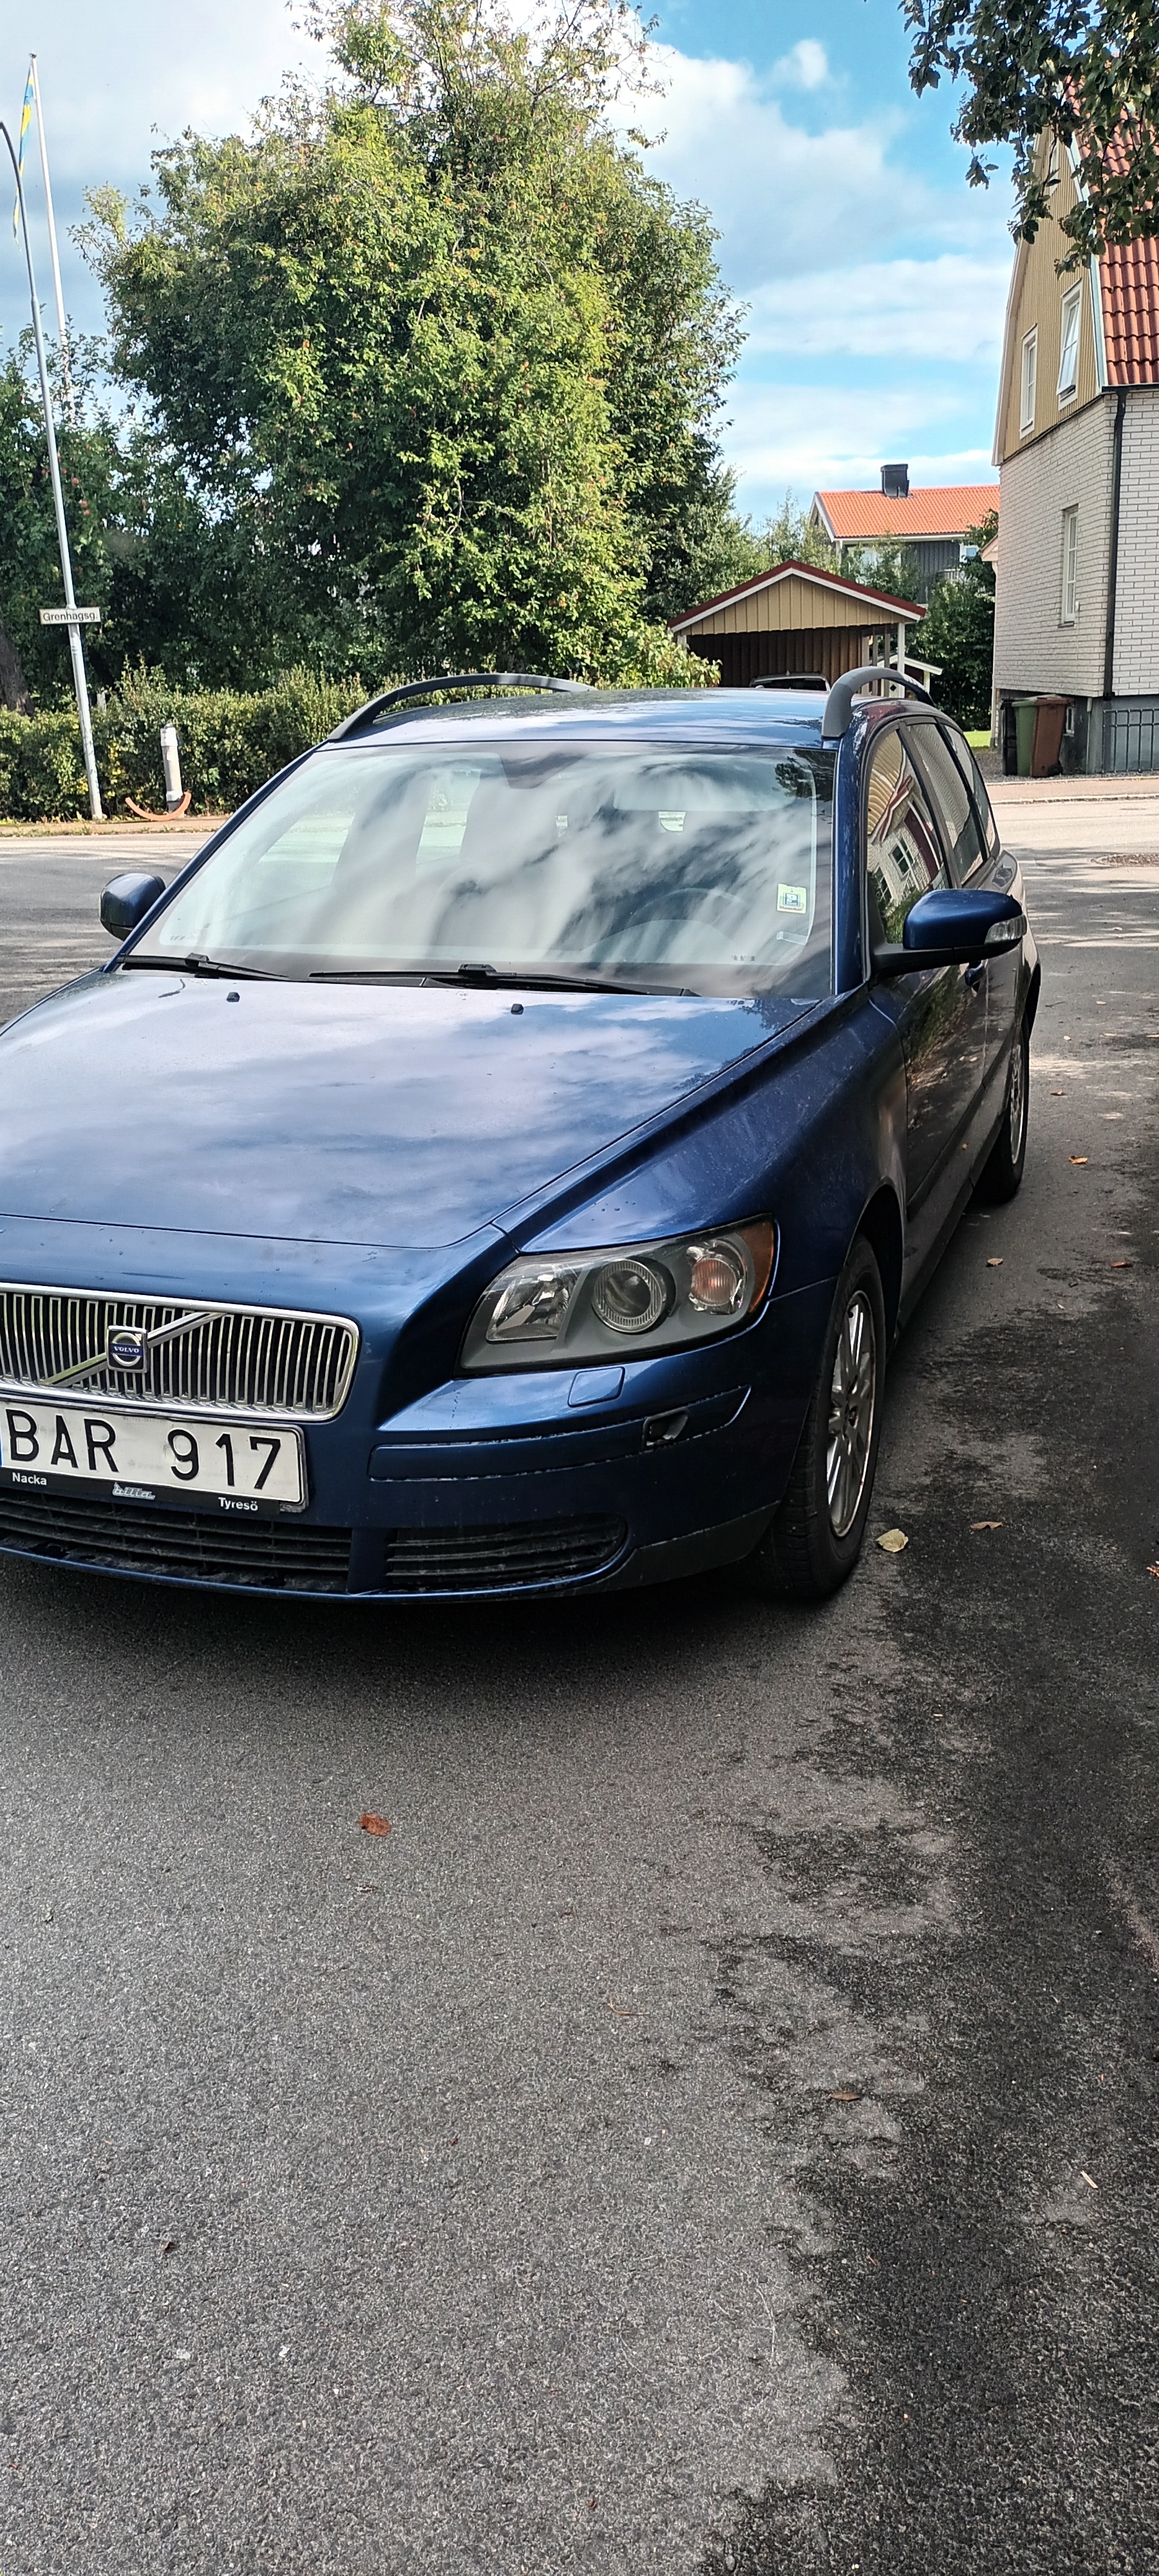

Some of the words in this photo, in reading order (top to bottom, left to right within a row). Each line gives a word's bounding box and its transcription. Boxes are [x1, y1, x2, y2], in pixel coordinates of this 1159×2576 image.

[5, 1408, 119, 1473] BAR
[167, 1428, 281, 1490] 917
[12, 1472, 47, 1486] Nacka
[218, 1497, 258, 1511] Tyresö
